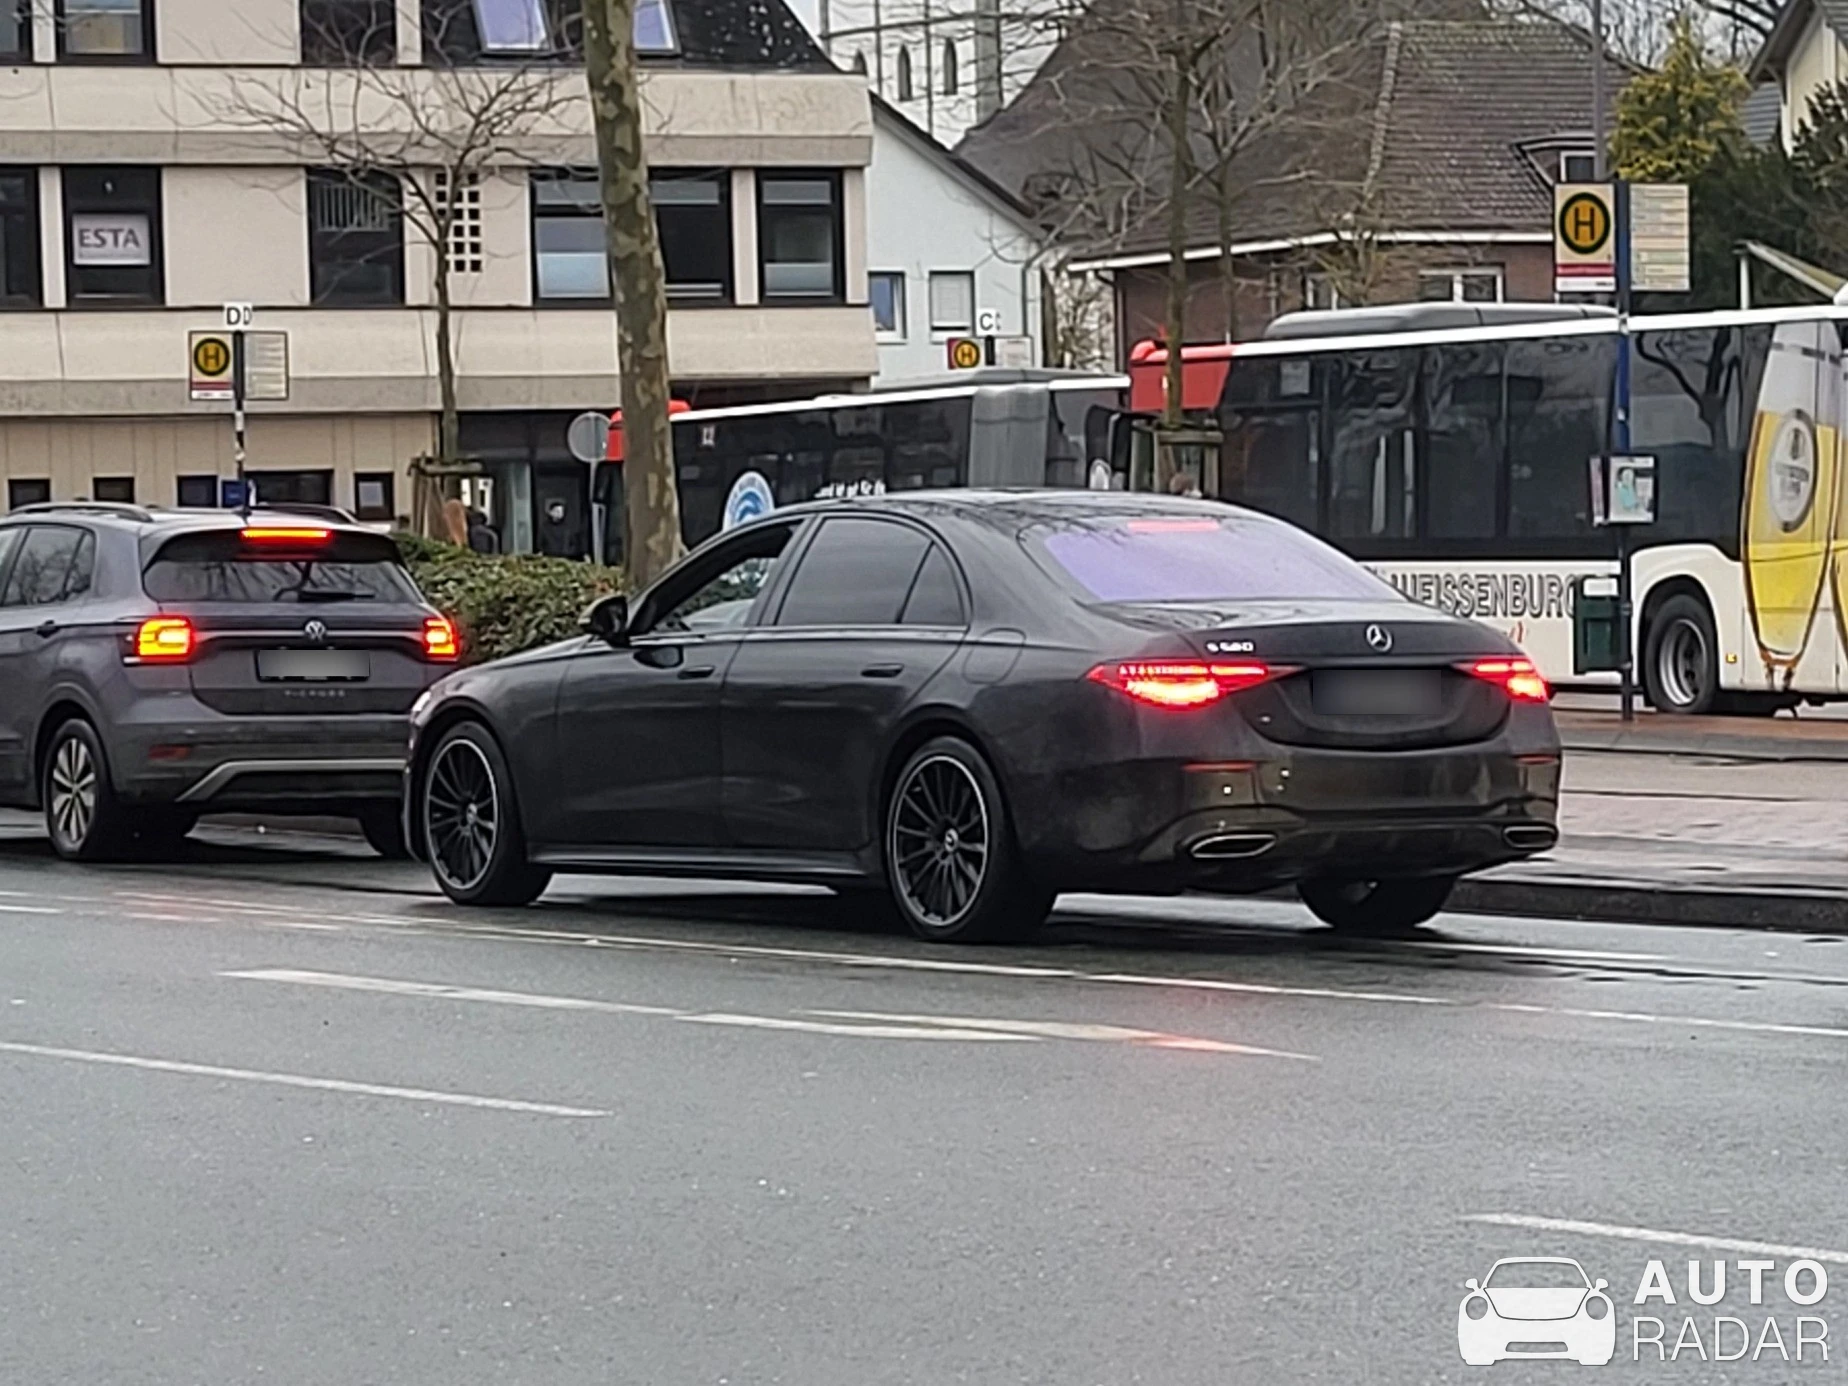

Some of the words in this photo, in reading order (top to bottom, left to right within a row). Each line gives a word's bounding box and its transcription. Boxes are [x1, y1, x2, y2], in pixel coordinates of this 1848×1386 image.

[1574, 206, 1595, 241] H
[79, 228, 140, 248] ESTA
[226, 306, 241, 325] D
[980, 312, 993, 331] C
[203, 346, 220, 368] H
